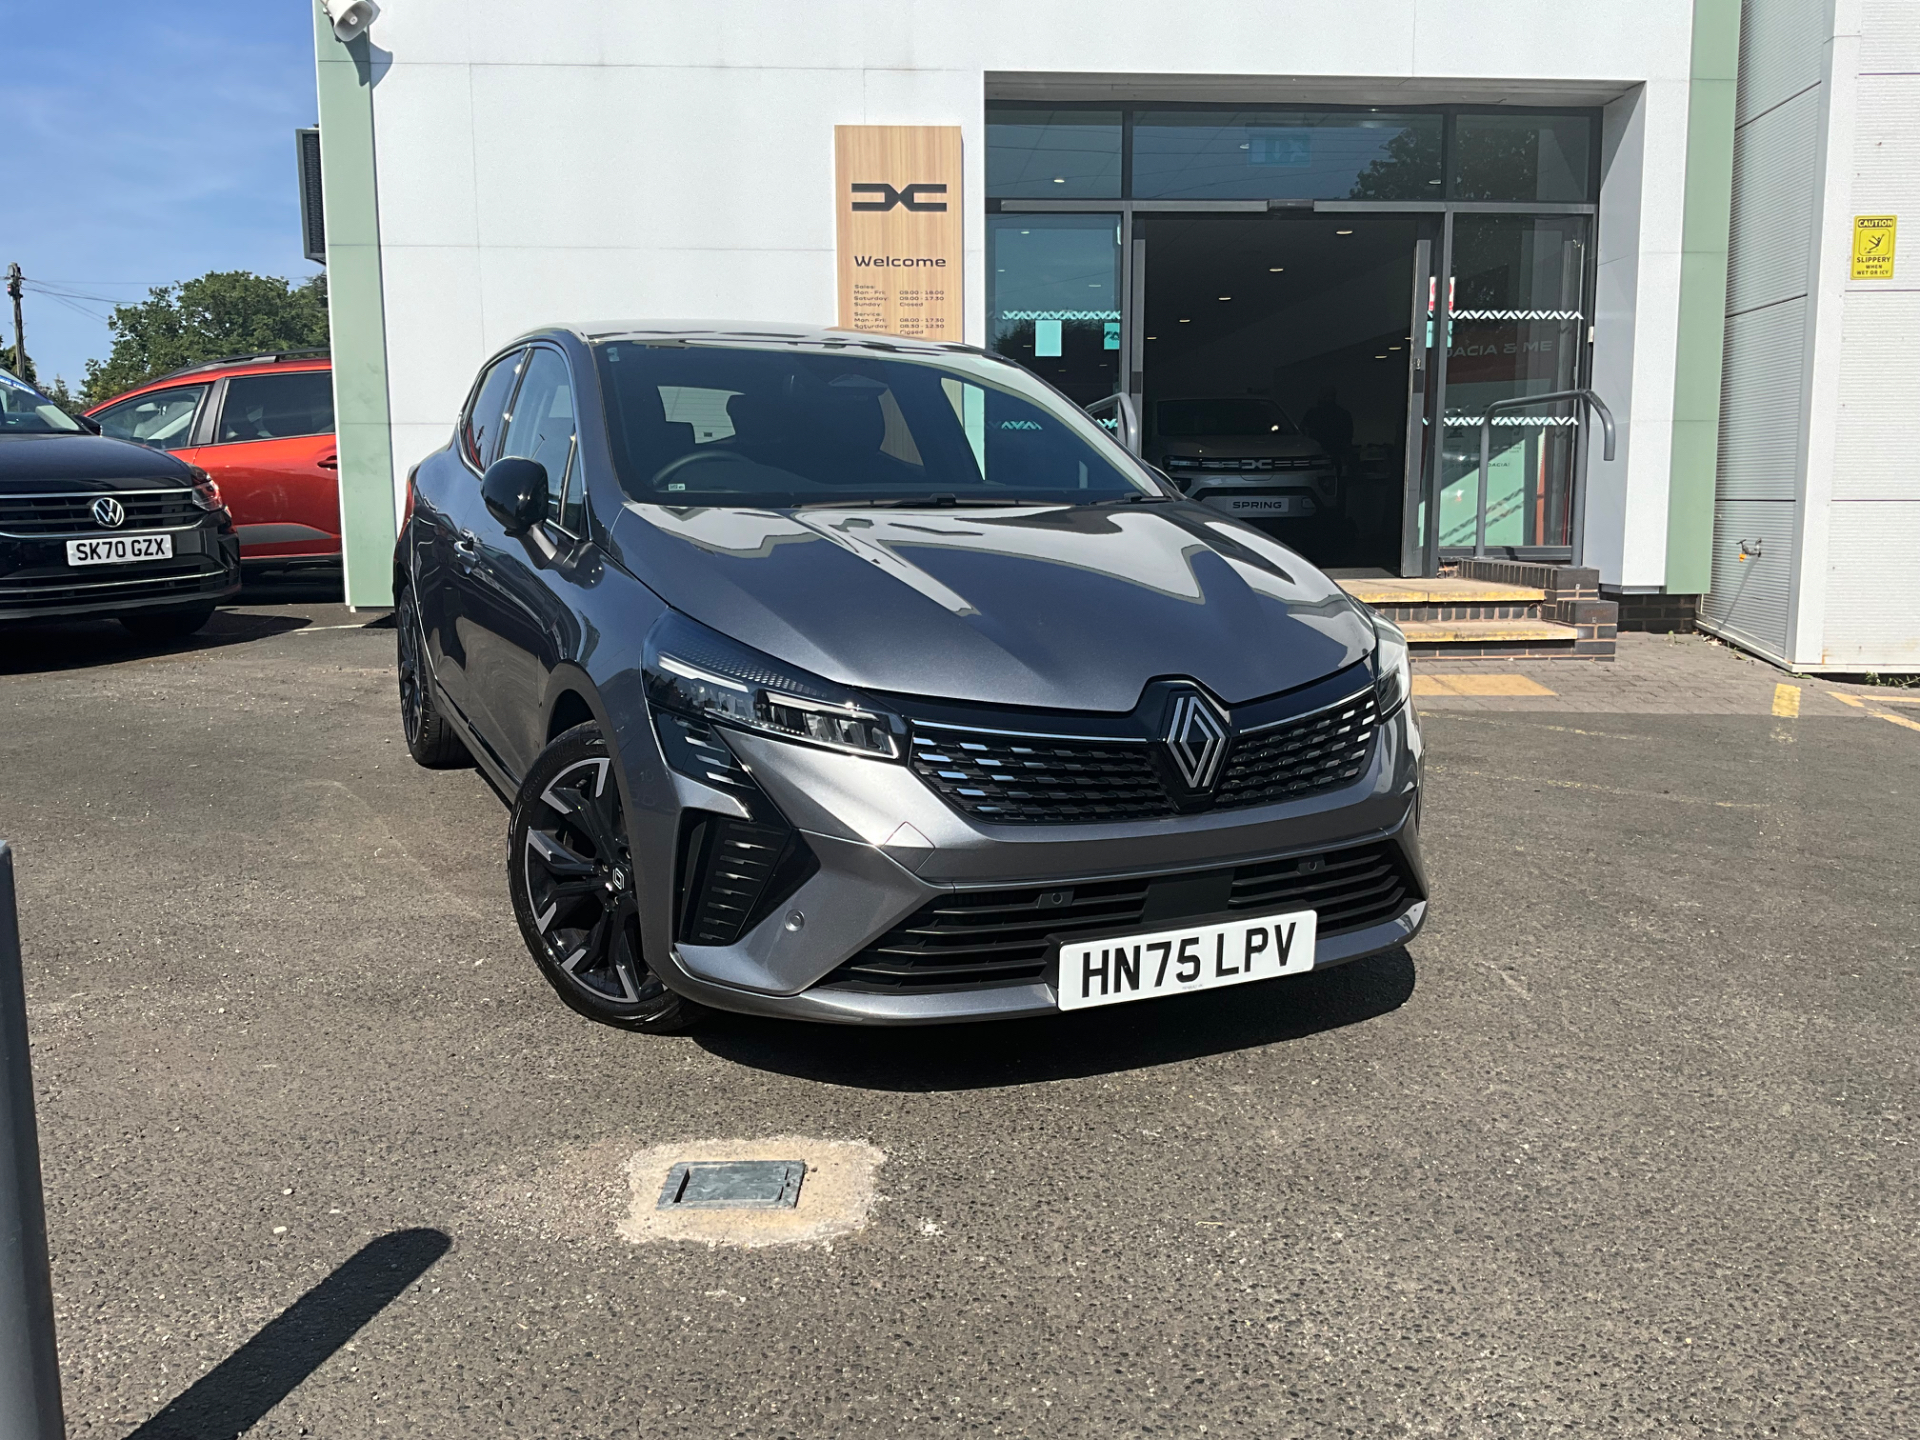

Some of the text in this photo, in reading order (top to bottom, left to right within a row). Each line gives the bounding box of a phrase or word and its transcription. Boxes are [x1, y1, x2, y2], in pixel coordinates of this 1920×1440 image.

[1858, 219, 1893, 227] CAUTION
[854, 256, 946, 267] Welcome
[1503, 343, 1518, 354] &
[1522, 341, 1553, 353] ME
[1232, 501, 1282, 509] SPRING
[75, 538, 166, 561] SK70 GZX
[1081, 921, 1297, 999] HN75 LPV
